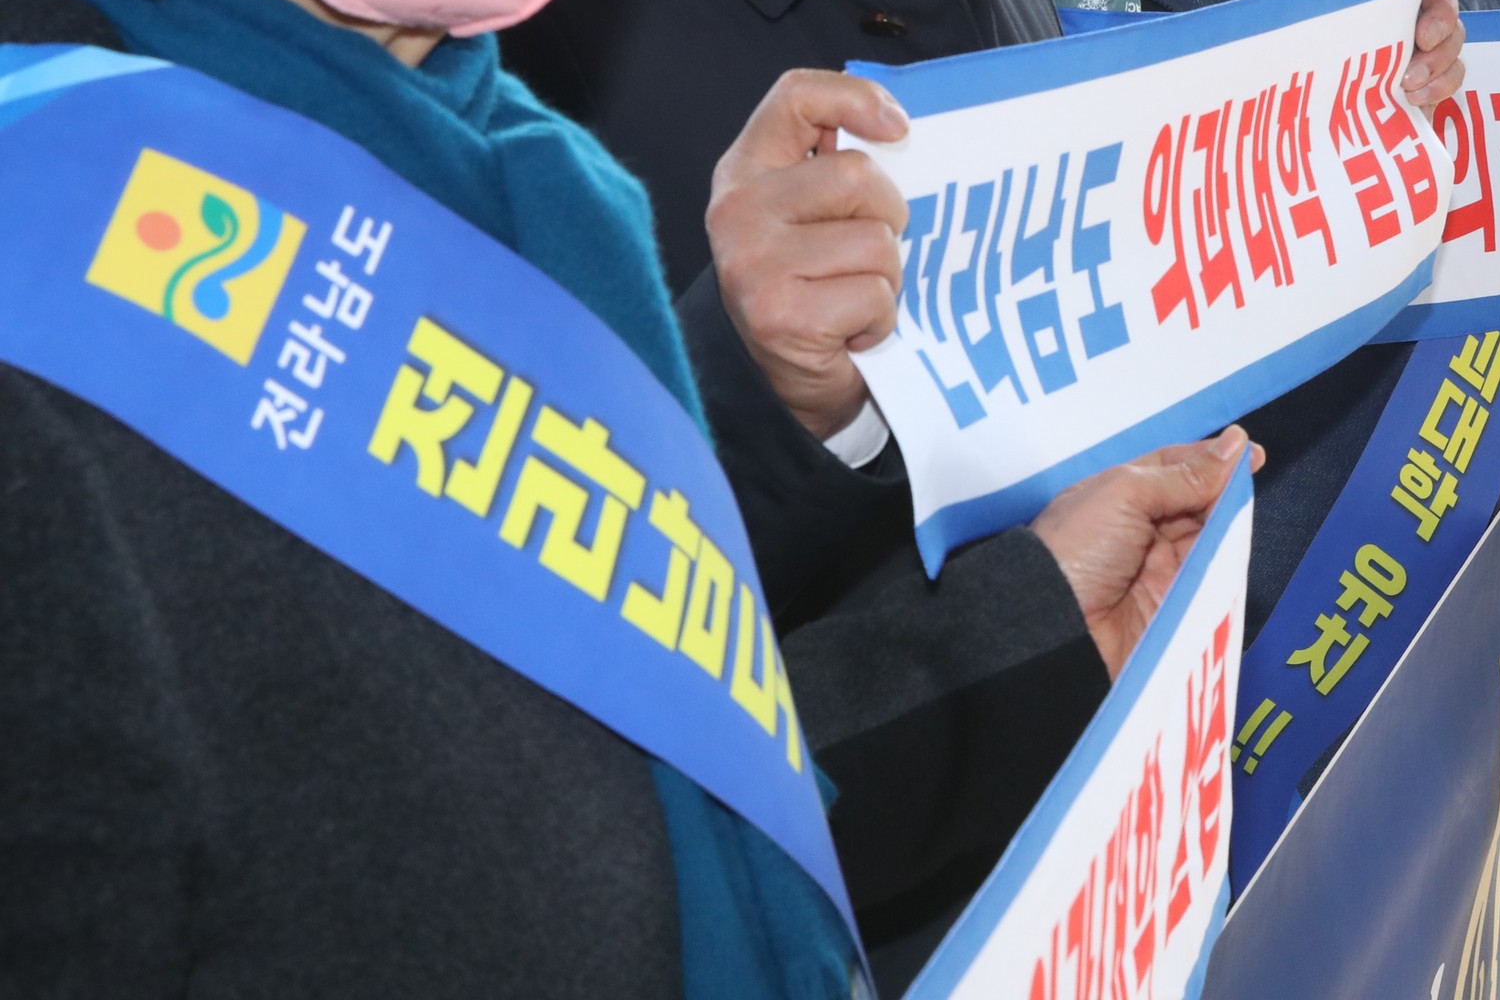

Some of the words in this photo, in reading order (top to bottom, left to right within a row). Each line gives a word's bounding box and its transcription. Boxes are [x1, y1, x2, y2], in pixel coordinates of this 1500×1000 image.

[1143, 70, 1338, 331] 의과대학
[1328, 40, 1440, 248] 설립
[251, 205, 392, 450] 전라남도
[1286, 543, 1409, 696] 유치
